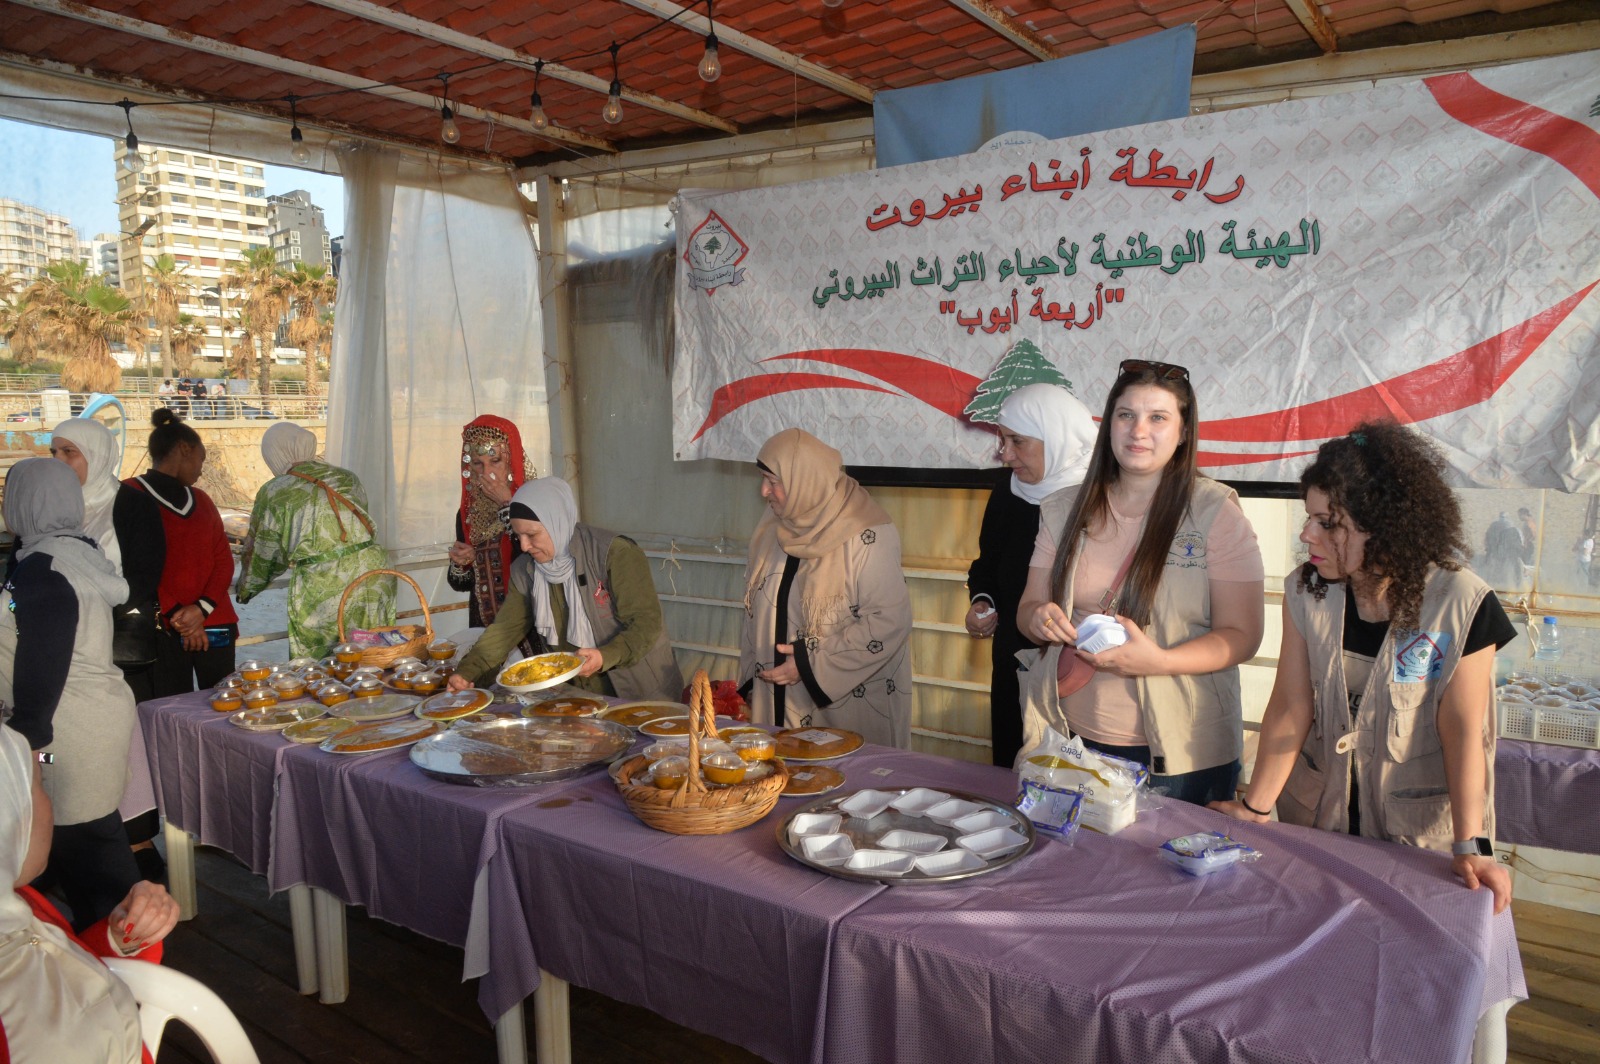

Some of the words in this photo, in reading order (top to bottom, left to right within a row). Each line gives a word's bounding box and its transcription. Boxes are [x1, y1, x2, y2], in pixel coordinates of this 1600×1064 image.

[1000, 146, 1092, 202] أبناء
[1108, 146, 1245, 205] رابطة
[866, 183, 983, 232] بيروت
[999, 237, 1079, 283] لأحياء
[1090, 230, 1206, 280] الوطنية
[1218, 218, 1320, 269] الهيئة
[812, 259, 901, 308] البيروتي
[909, 251, 986, 292] التراث
